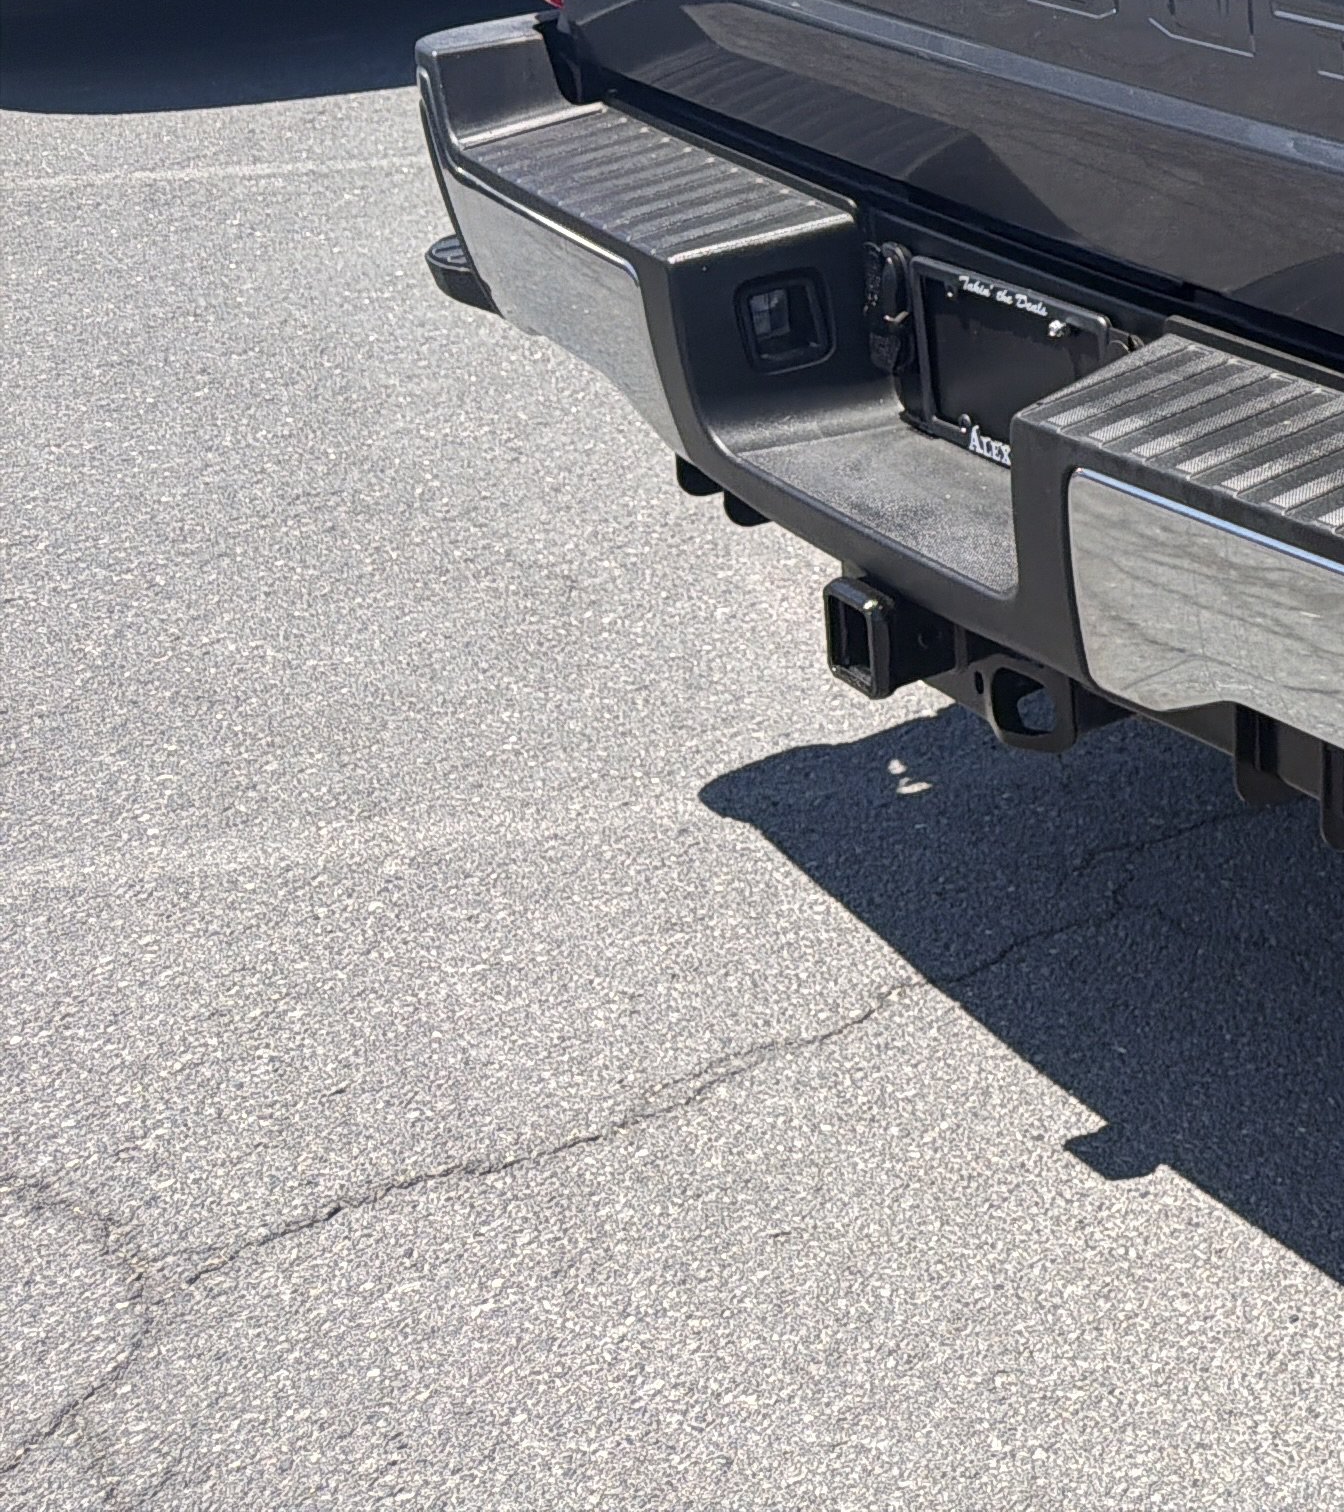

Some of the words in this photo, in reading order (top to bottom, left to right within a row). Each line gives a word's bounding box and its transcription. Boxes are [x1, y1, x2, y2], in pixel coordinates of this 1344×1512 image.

[958, 275, 994, 298] Takin'
[996, 289, 1013, 305] the
[1015, 293, 1048, 317] Deals
